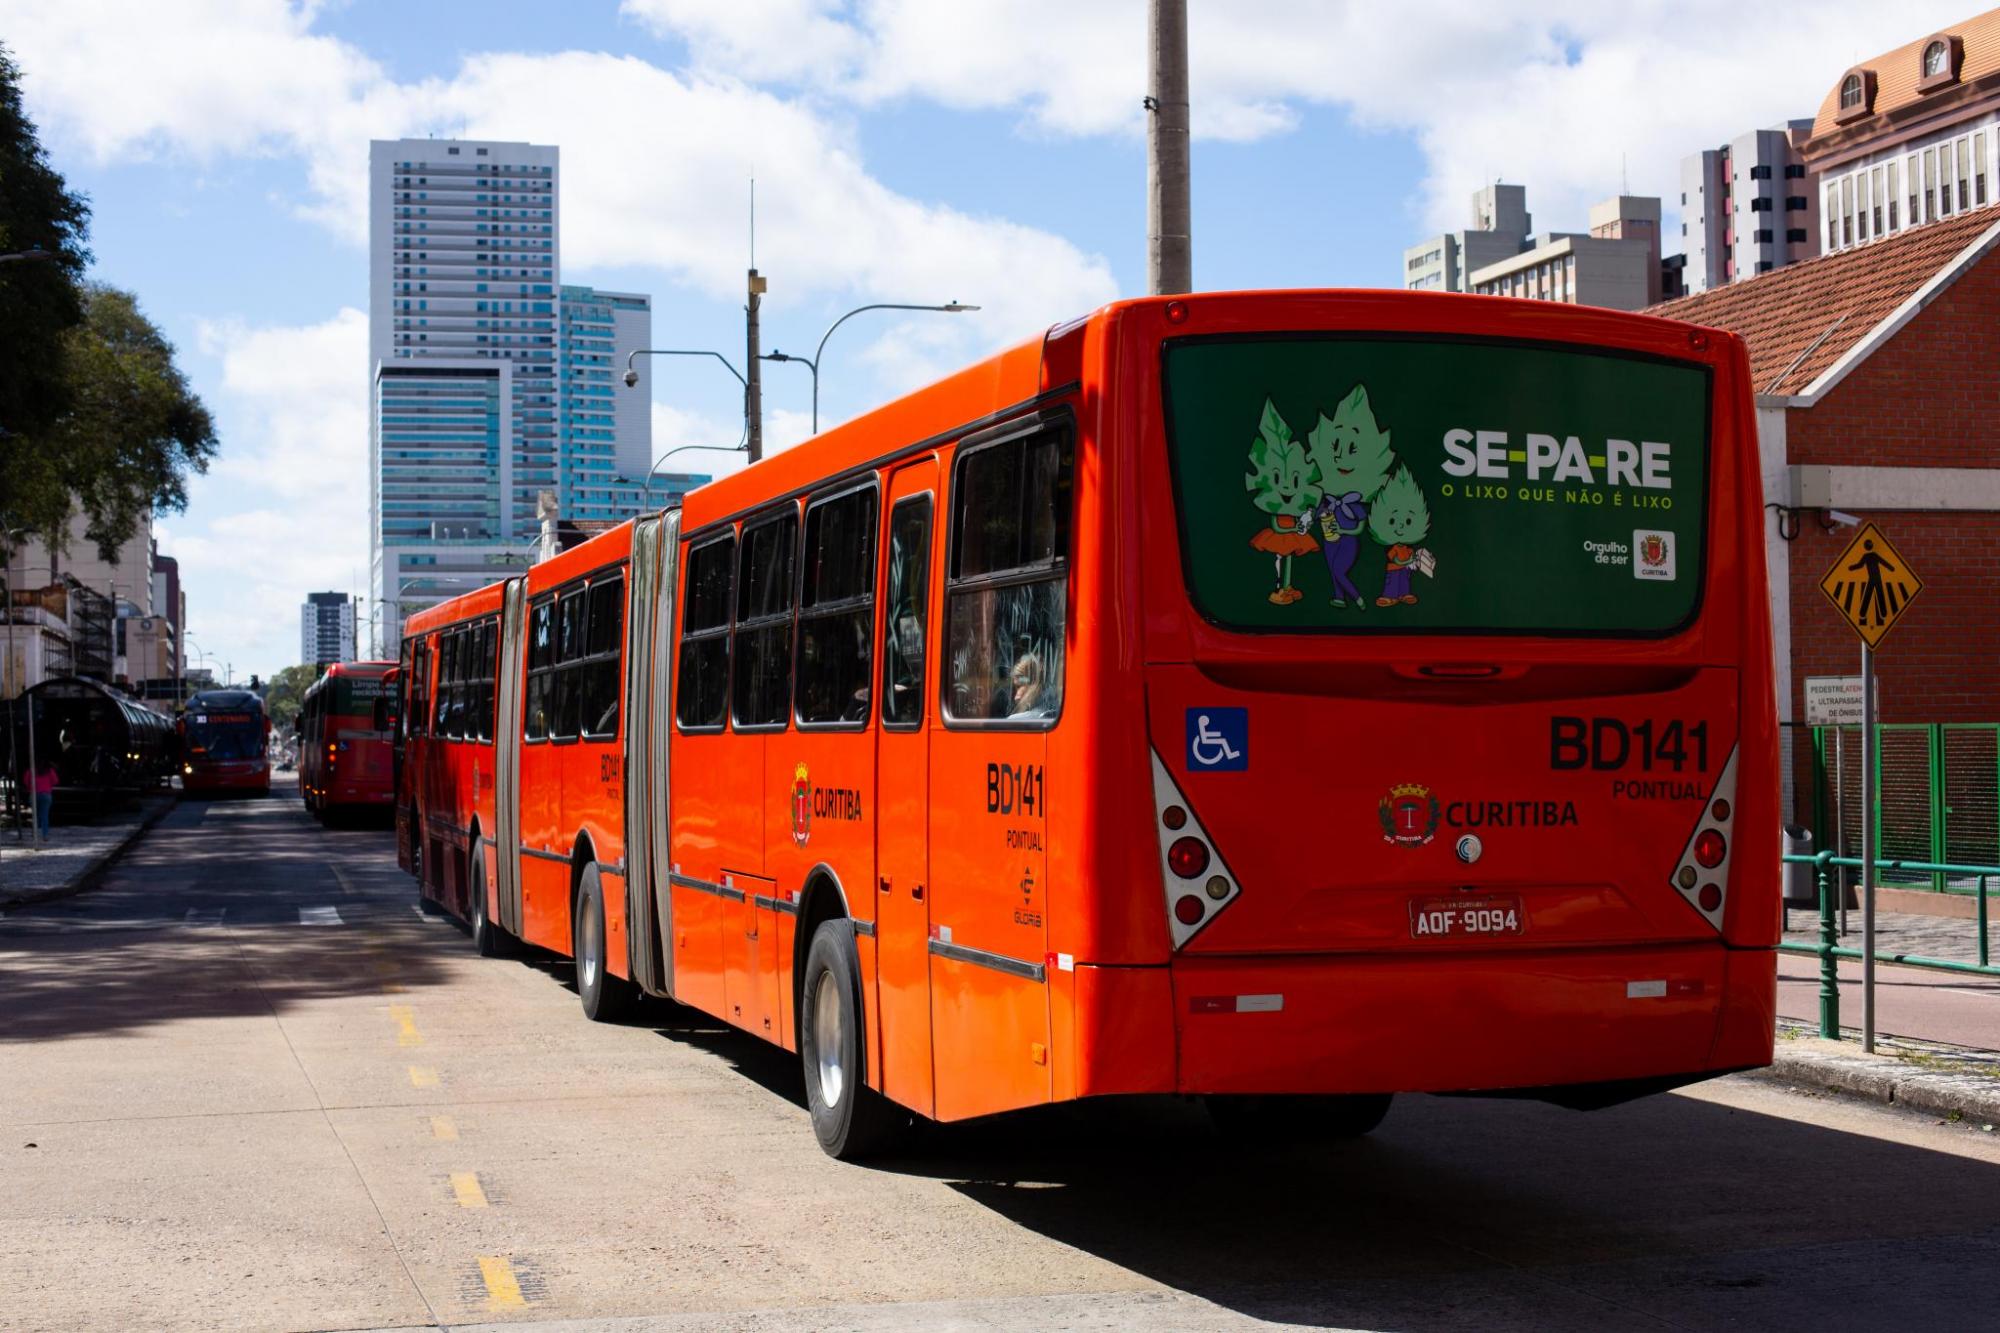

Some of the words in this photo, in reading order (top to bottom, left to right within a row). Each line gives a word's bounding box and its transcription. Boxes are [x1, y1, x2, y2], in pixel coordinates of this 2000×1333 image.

[1441, 428, 1672, 489] SE-PA-RE
[1441, 484, 1454, 497] O
[1465, 485, 1508, 499] LIXO
[1518, 488, 1554, 502] QUE
[1566, 489, 1604, 505] NÃO
[1614, 491, 1622, 506] É
[1633, 495, 1672, 509] LIXO
[1583, 541, 1628, 555] Orgulho
[1594, 551, 1609, 564] de
[1611, 555, 1628, 565] ser
[1829, 709, 1838, 717] DE
[1551, 716, 1707, 772] BD141
[987, 763, 1044, 818] BD141
[1613, 780, 1709, 801] PONTUAL
[814, 787, 862, 821] CURITIBA
[1446, 801, 1578, 827] CURITIBA
[1007, 829, 1043, 851] PONTUAL
